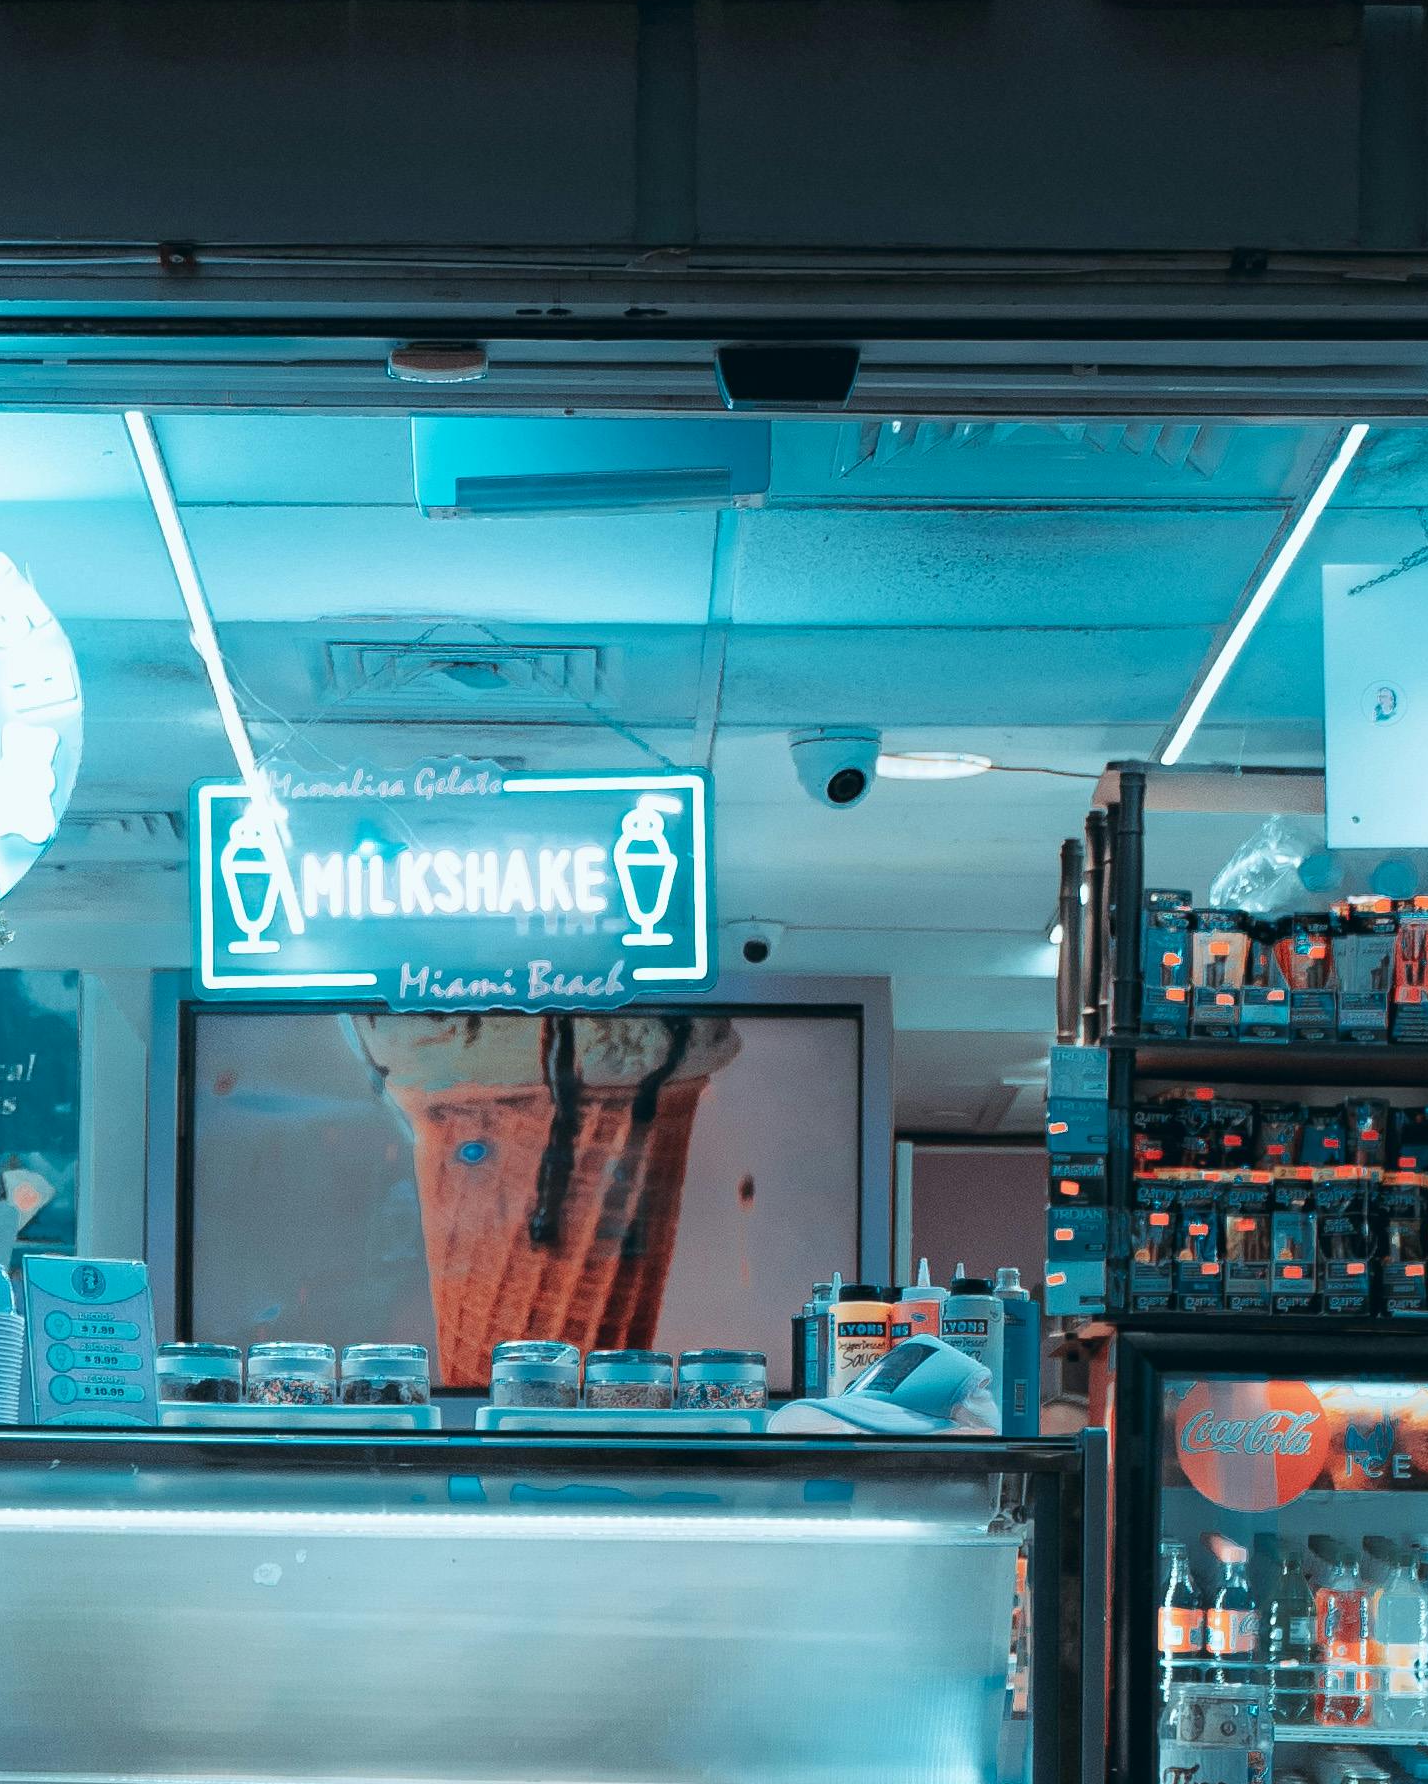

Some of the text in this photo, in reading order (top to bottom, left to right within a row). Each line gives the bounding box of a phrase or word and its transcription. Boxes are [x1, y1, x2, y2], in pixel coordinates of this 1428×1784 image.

[300, 846, 608, 919] MILKSHAKE
[399, 958, 625, 1000] Miami Beach
[839, 1323, 885, 1337] LYONS
[942, 1321, 986, 1335] LYONS
[1344, 1454, 1412, 1479] ICE
